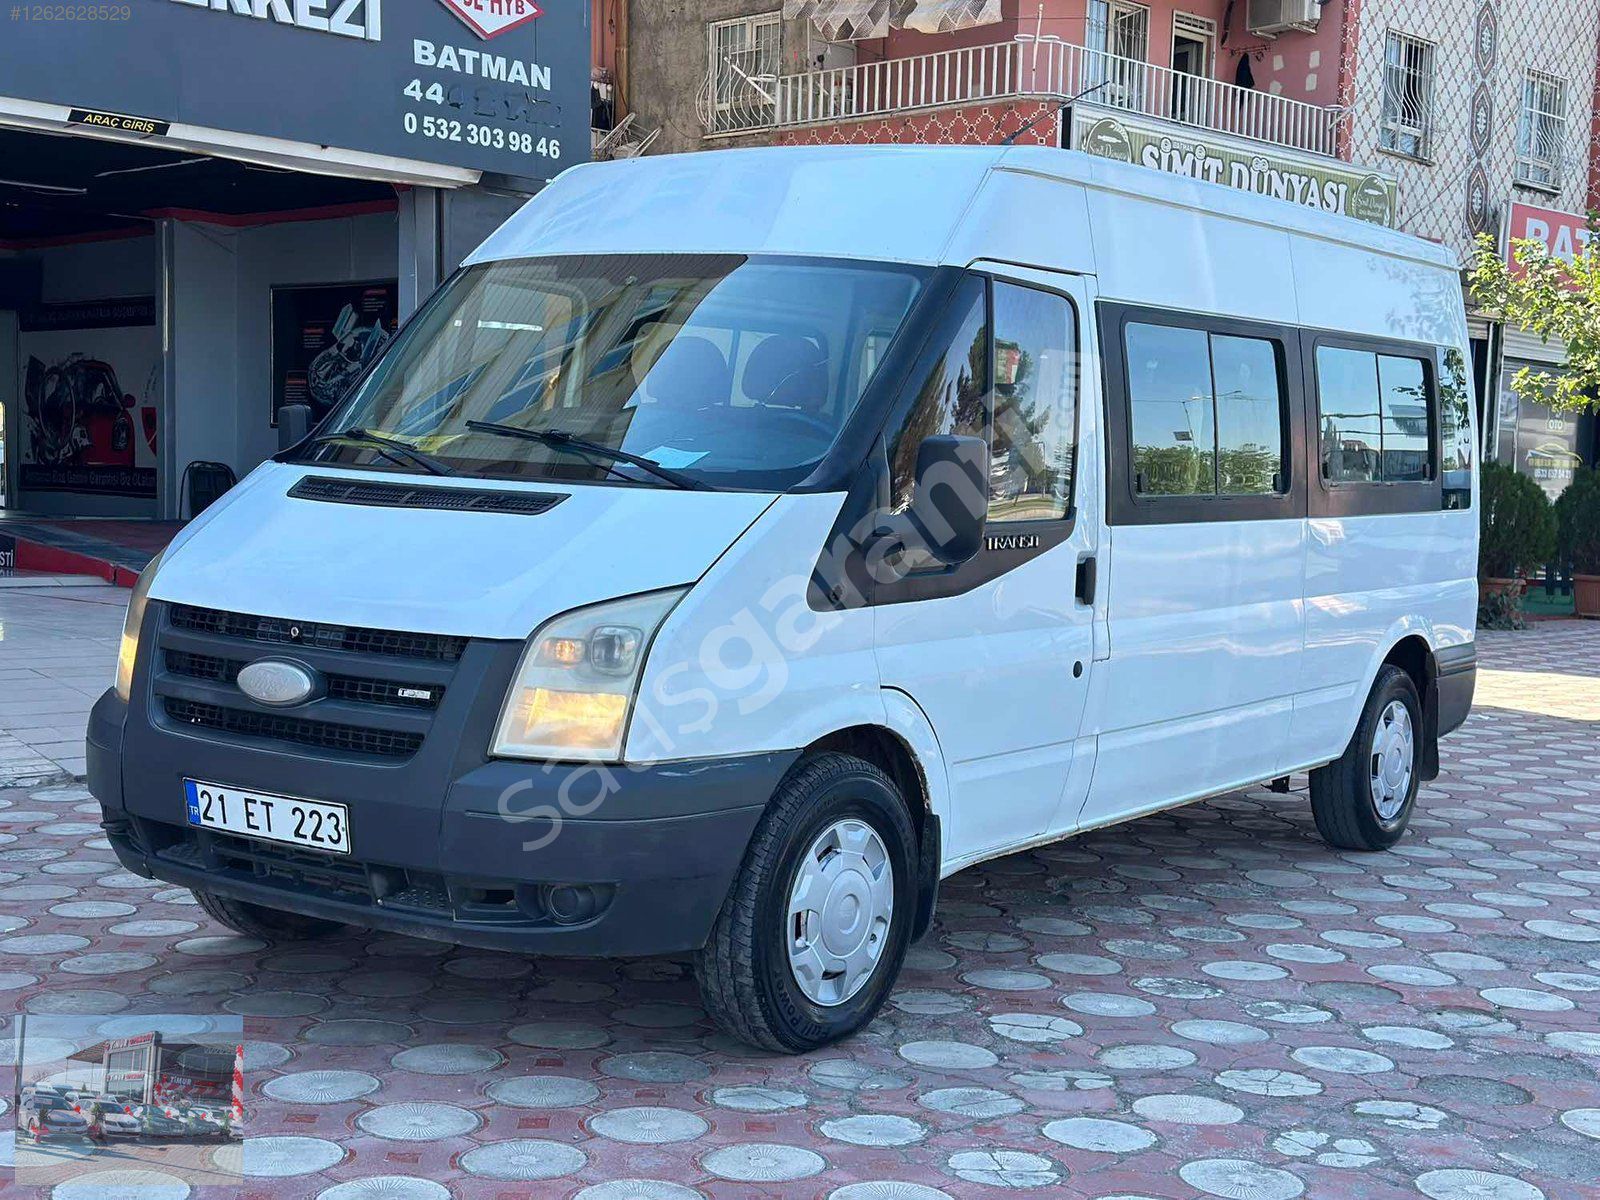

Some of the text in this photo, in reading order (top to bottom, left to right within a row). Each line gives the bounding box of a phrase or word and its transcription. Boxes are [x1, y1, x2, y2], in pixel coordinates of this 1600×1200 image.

[413, 38, 551, 91] BATMAN
[83, 113, 155, 133] ARAÇ GİRİŞ
[404, 112, 561, 159] 0 532 303 98 46
[1142, 137, 1348, 215] SİMİT DÜNYASI
[189, 805, 199, 816] TR
[200, 790, 342, 845] 21 ET 223
